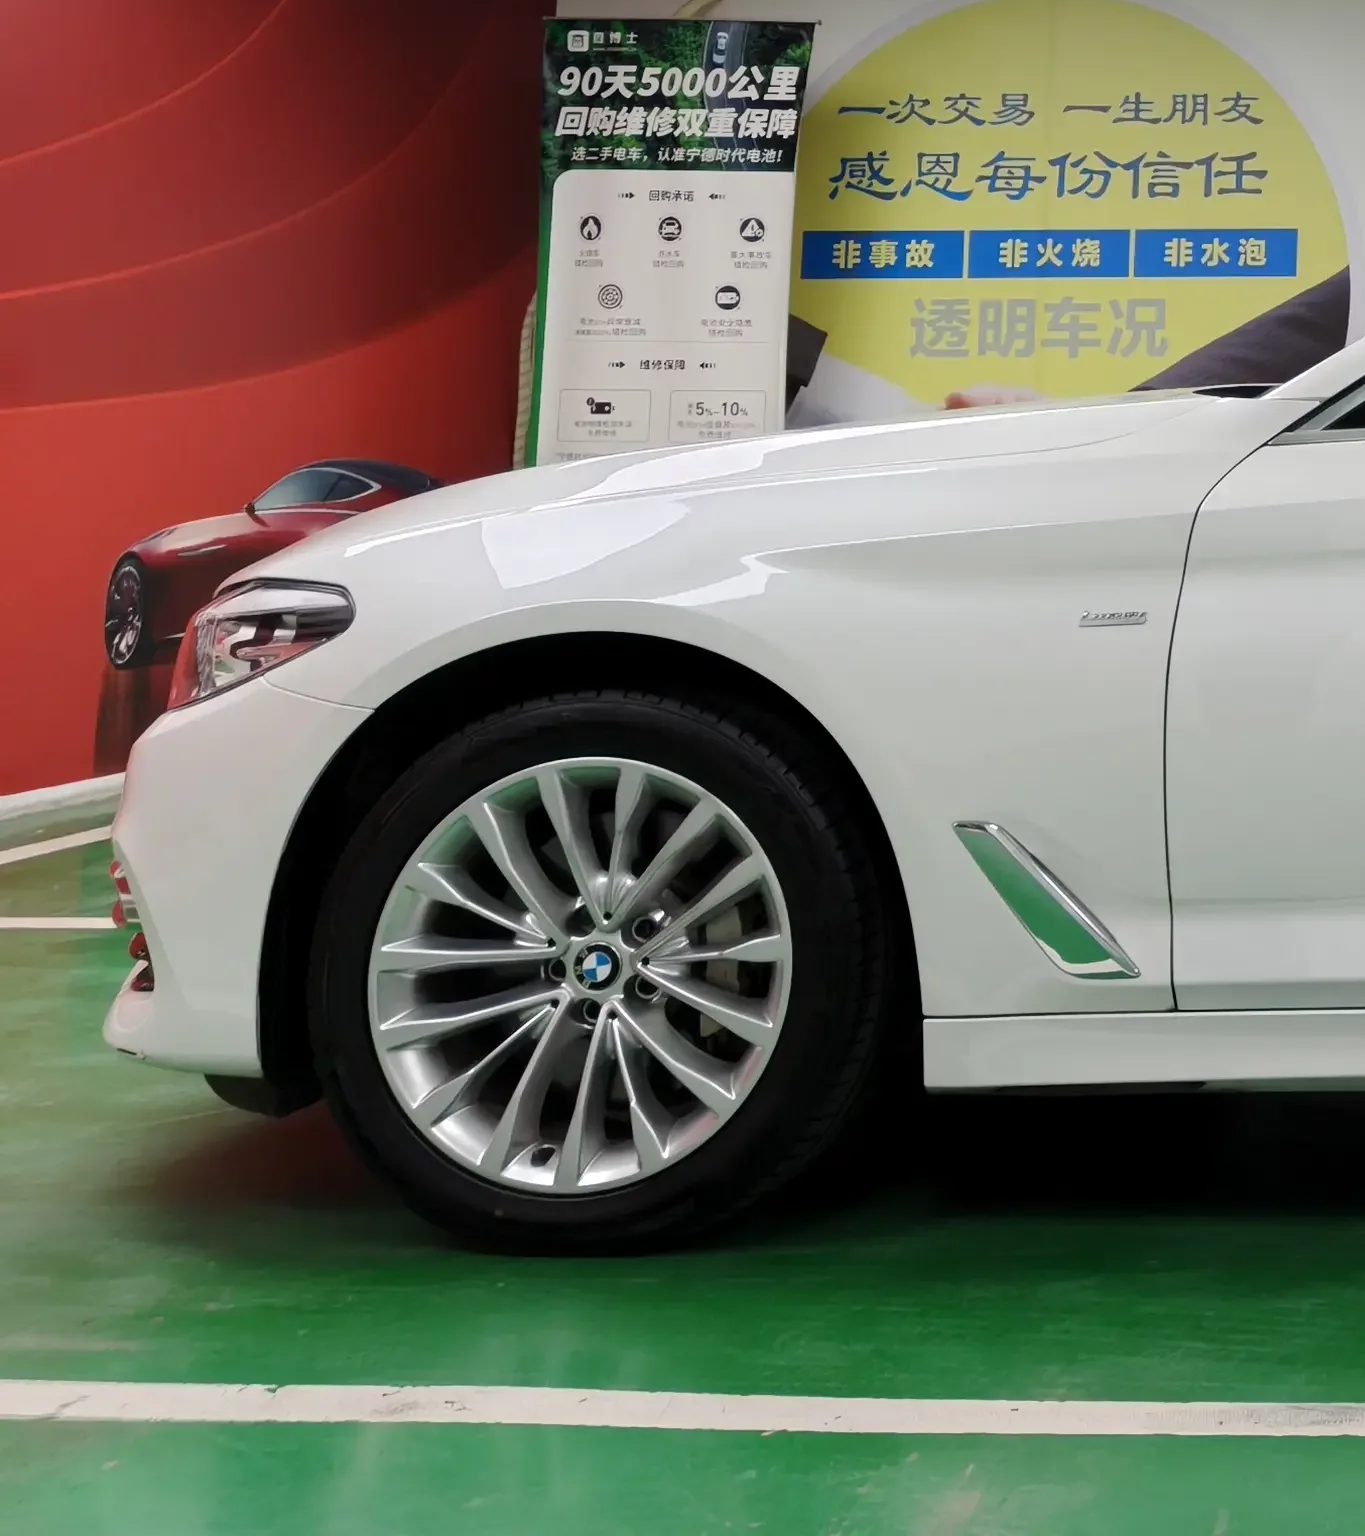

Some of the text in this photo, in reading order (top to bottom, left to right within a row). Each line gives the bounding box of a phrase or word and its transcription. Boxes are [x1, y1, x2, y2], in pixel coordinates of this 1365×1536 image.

[557, 64, 800, 101] 90天5000公里
[555, 106, 797, 139] 回购维修双重保障
[837, 90, 1264, 127] 一次交易 一生朋友
[828, 150, 1269, 202] 感恩每份信任
[649, 189, 694, 202] 回购承诺
[831, 238, 935, 269] 非事故
[999, 238, 1101, 269] 非火烧
[1163, 237, 1268, 267] 非水泡
[910, 295, 1169, 358] 透明车况
